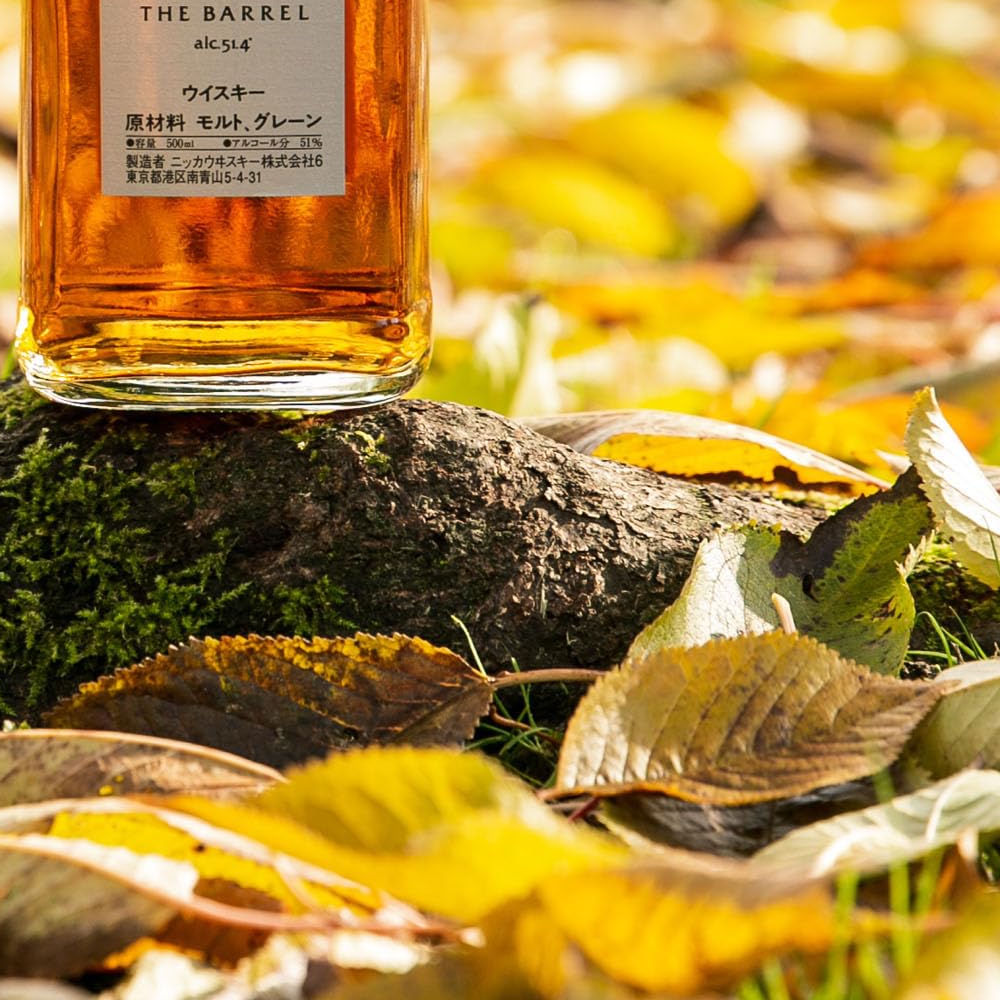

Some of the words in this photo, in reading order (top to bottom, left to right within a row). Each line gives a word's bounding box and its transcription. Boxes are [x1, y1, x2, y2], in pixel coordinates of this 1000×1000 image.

[140, 5, 190, 22] THE
[203, 5, 310, 22] BARREL
[182, 84, 266, 102] ウイスキー
[125, 113, 186, 132] 原材料
[166, 138, 195, 149] 500ml
[300, 138, 323, 148] 51%
[125, 154, 166, 169] 製造者
